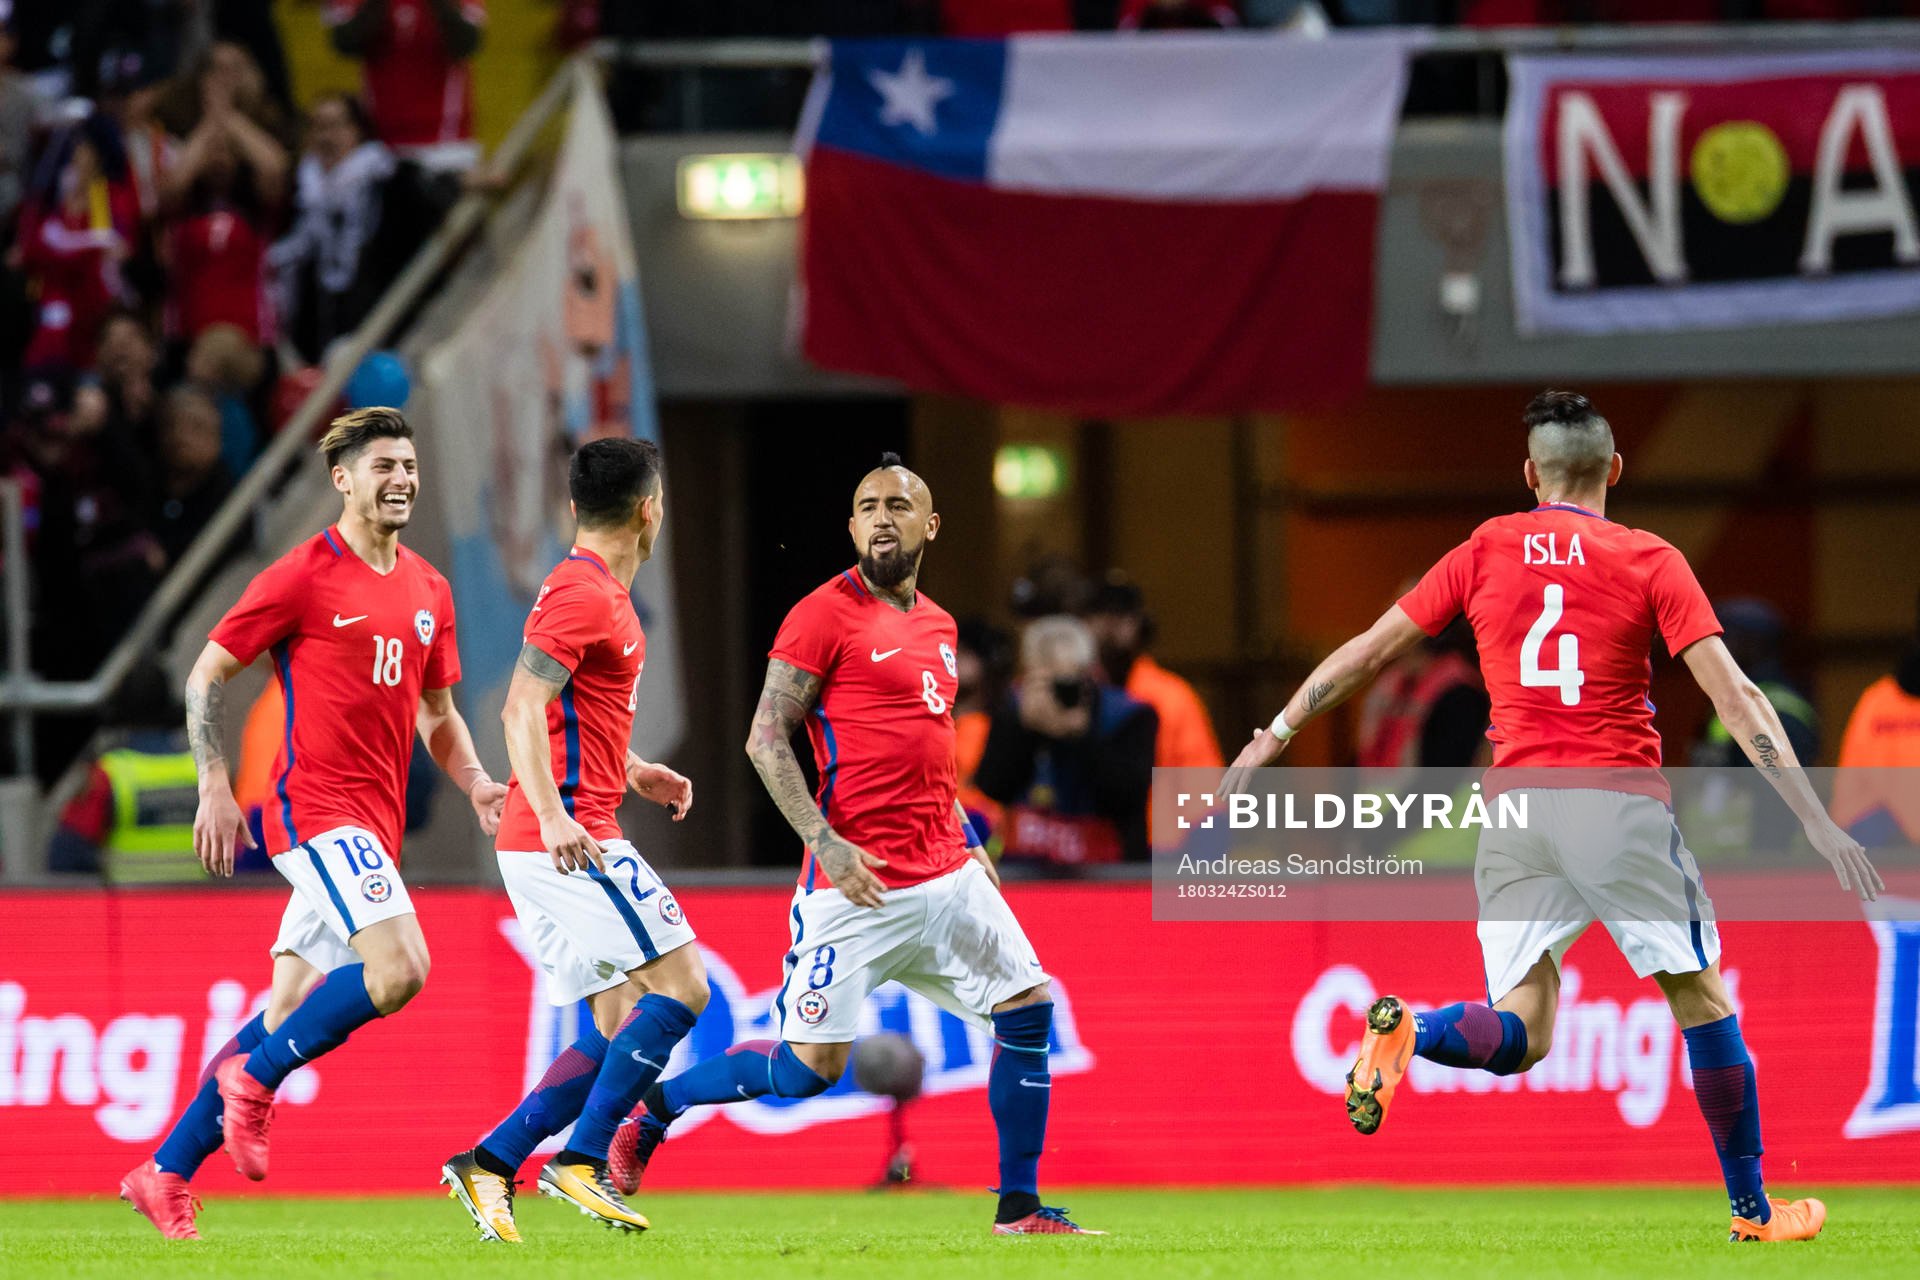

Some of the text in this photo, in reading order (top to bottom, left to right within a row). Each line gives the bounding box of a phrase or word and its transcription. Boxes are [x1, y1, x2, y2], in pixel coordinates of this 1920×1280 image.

[1523, 532, 1585, 566] ISLA
[372, 634, 404, 687] 18
[1519, 583, 1585, 706] 4
[921, 670, 946, 715] 8
[333, 835, 384, 876] 18
[808, 944, 836, 990] 8
